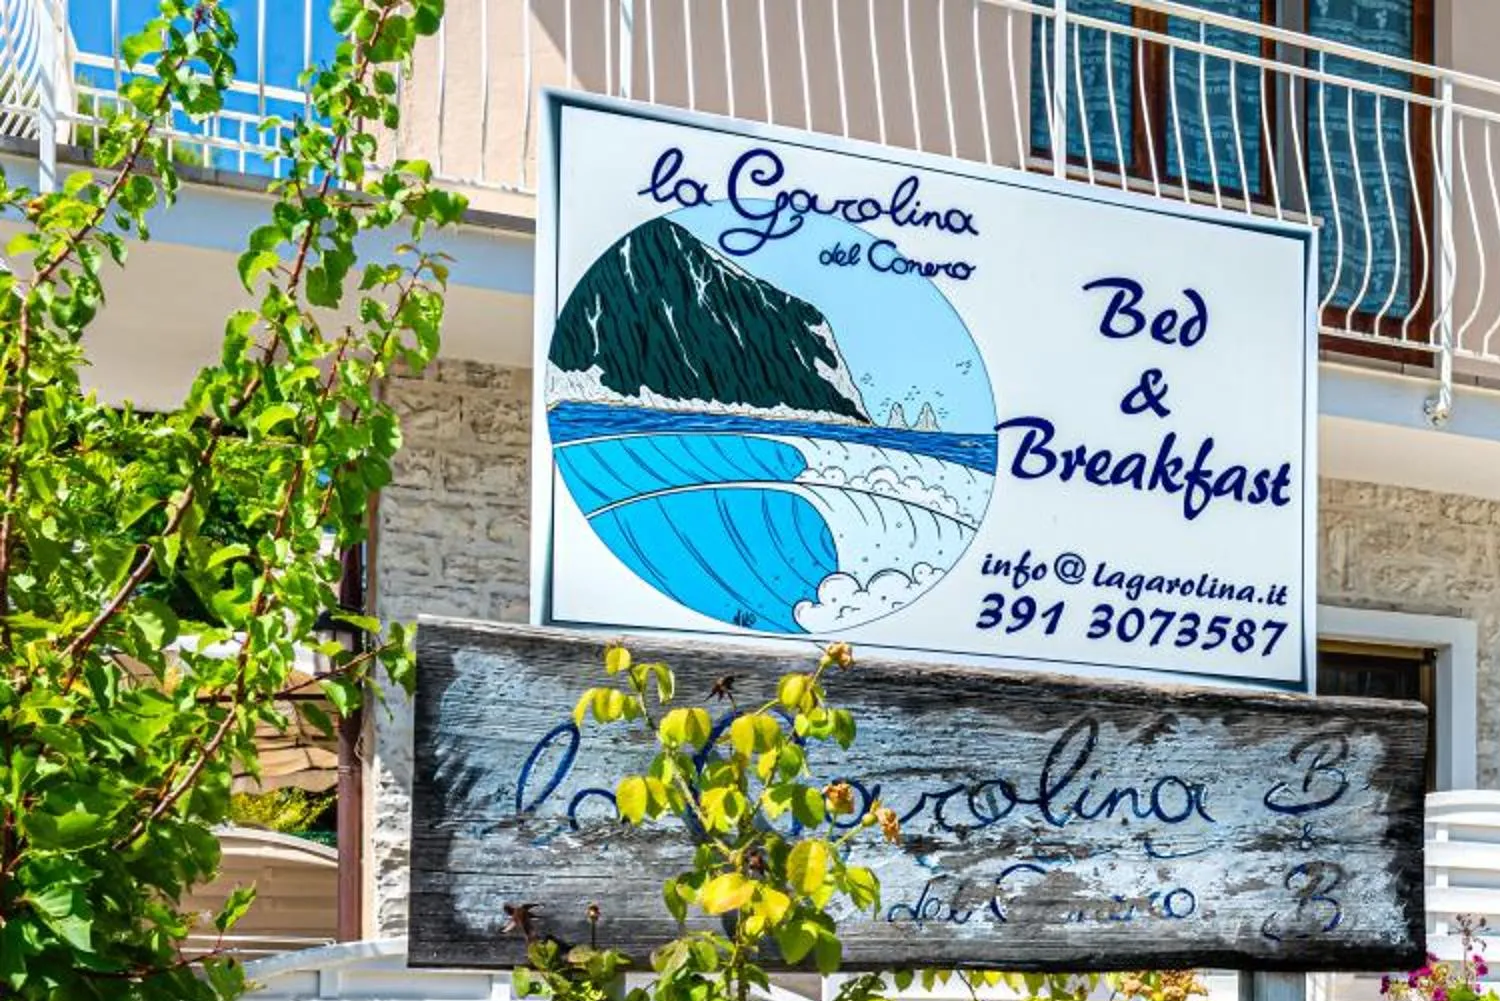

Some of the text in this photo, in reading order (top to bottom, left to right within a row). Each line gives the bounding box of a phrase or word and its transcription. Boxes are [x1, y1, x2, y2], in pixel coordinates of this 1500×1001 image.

[638, 148, 980, 257] la Garolina
[819, 239, 977, 281] del Conero
[1082, 277, 1208, 347] Bed
[1120, 367, 1171, 418] &
[994, 416, 1292, 521] Breakfast
[976, 592, 1289, 658] 391 3073587
[1263, 731, 1349, 815] B
